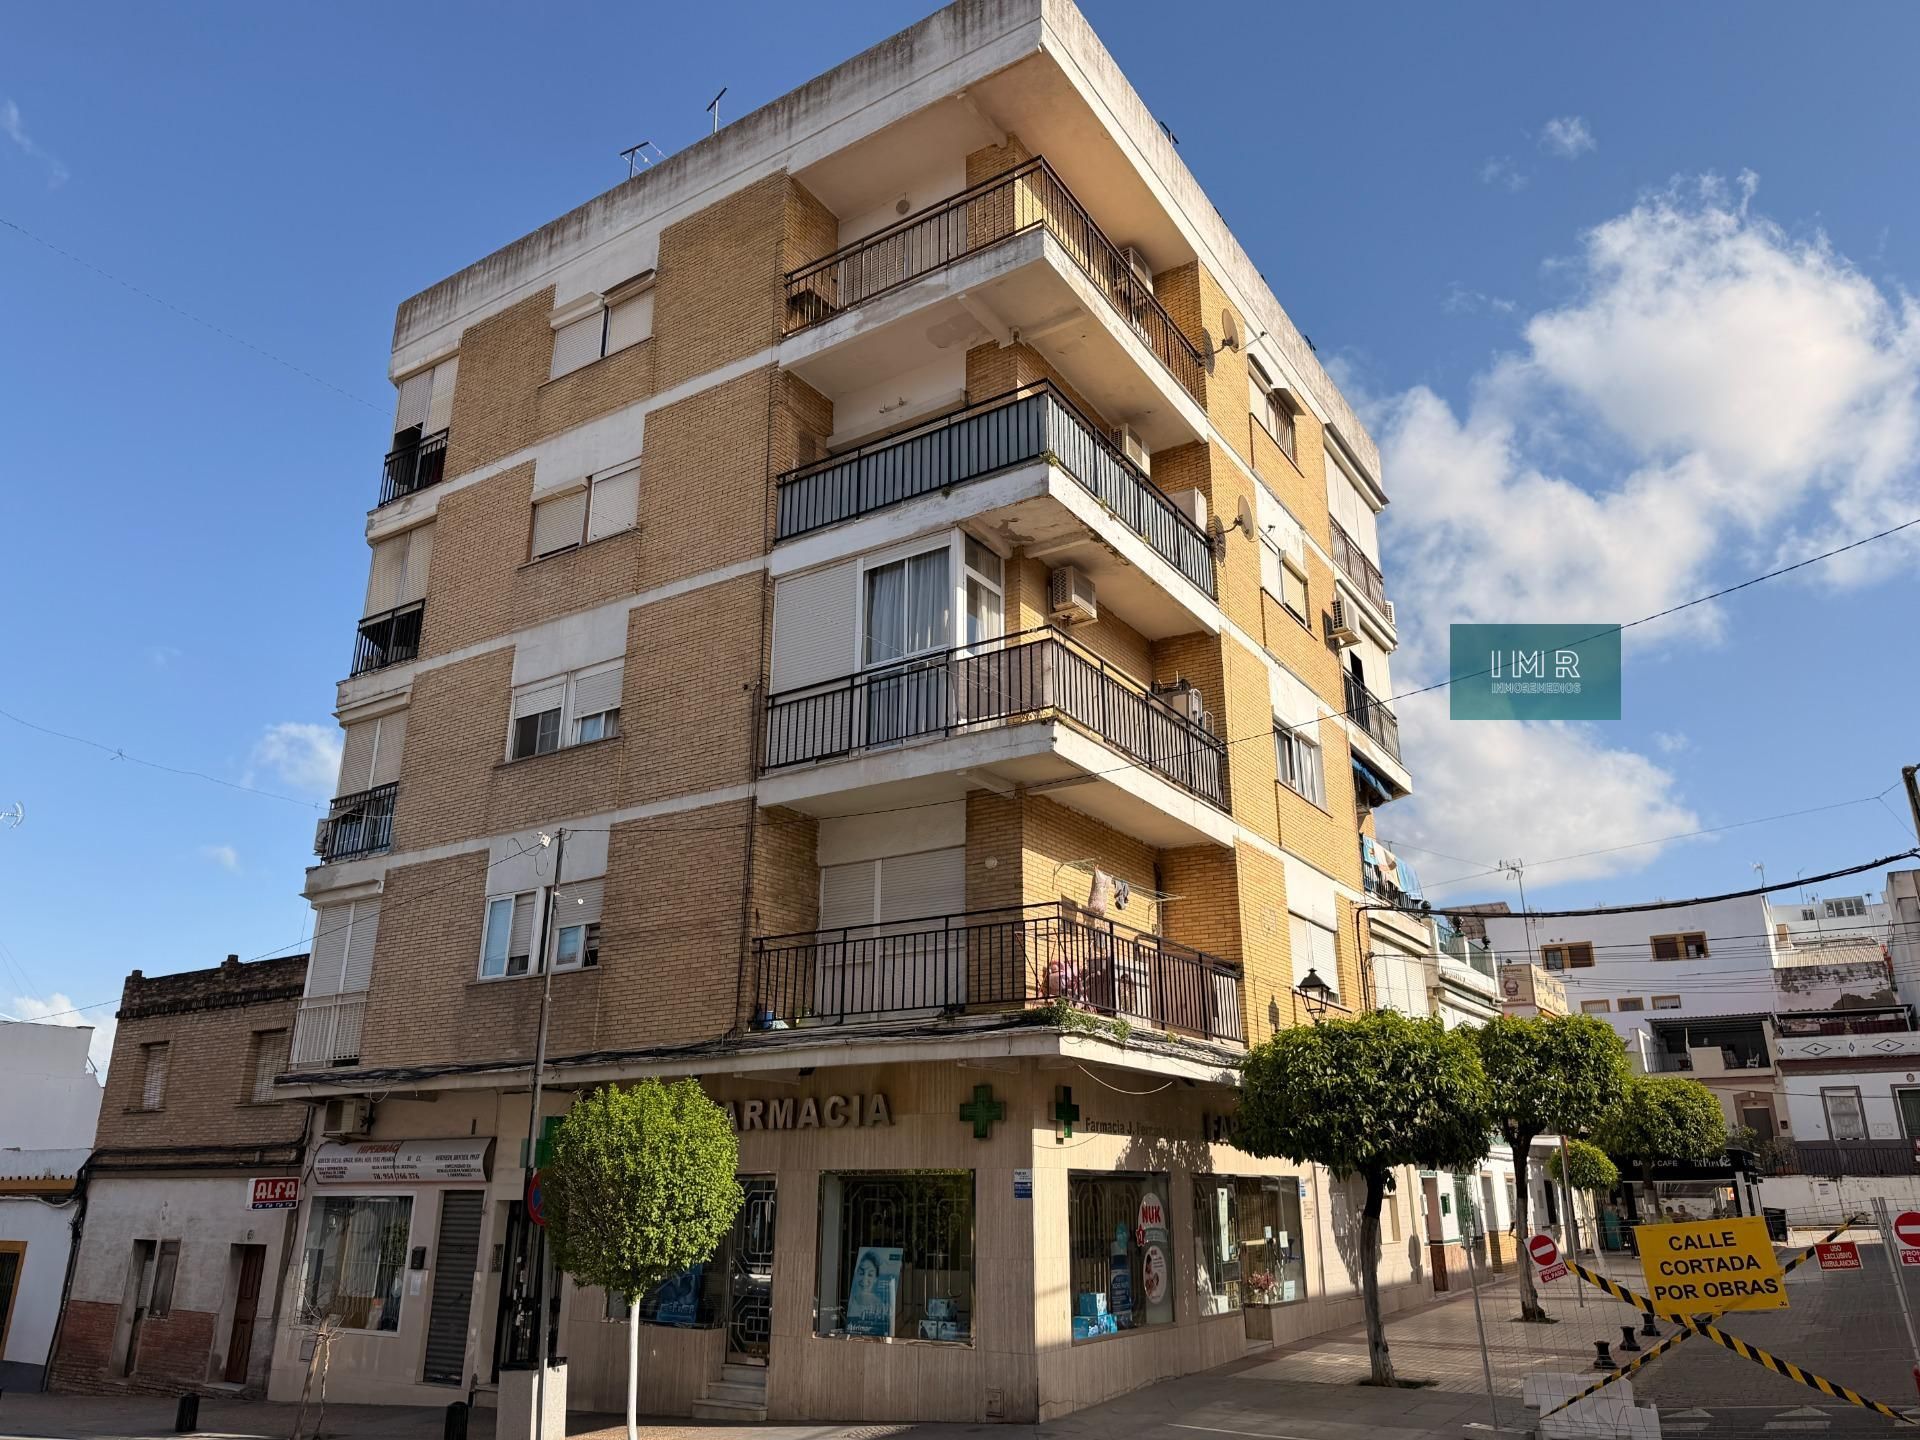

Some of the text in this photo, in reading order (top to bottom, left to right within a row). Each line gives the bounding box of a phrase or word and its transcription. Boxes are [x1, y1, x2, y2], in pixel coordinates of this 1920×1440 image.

[723, 1094, 894, 1132] ARMACIA
[1086, 1117, 1125, 1132] Farmacia
[255, 1181, 296, 1200] ALFA
[1141, 1205, 1161, 1224] NUK
[1669, 1231, 1737, 1251] CALLE
[1660, 1254, 1761, 1276] CORTADA
[1654, 1278, 1779, 1300] POR OBRAS
